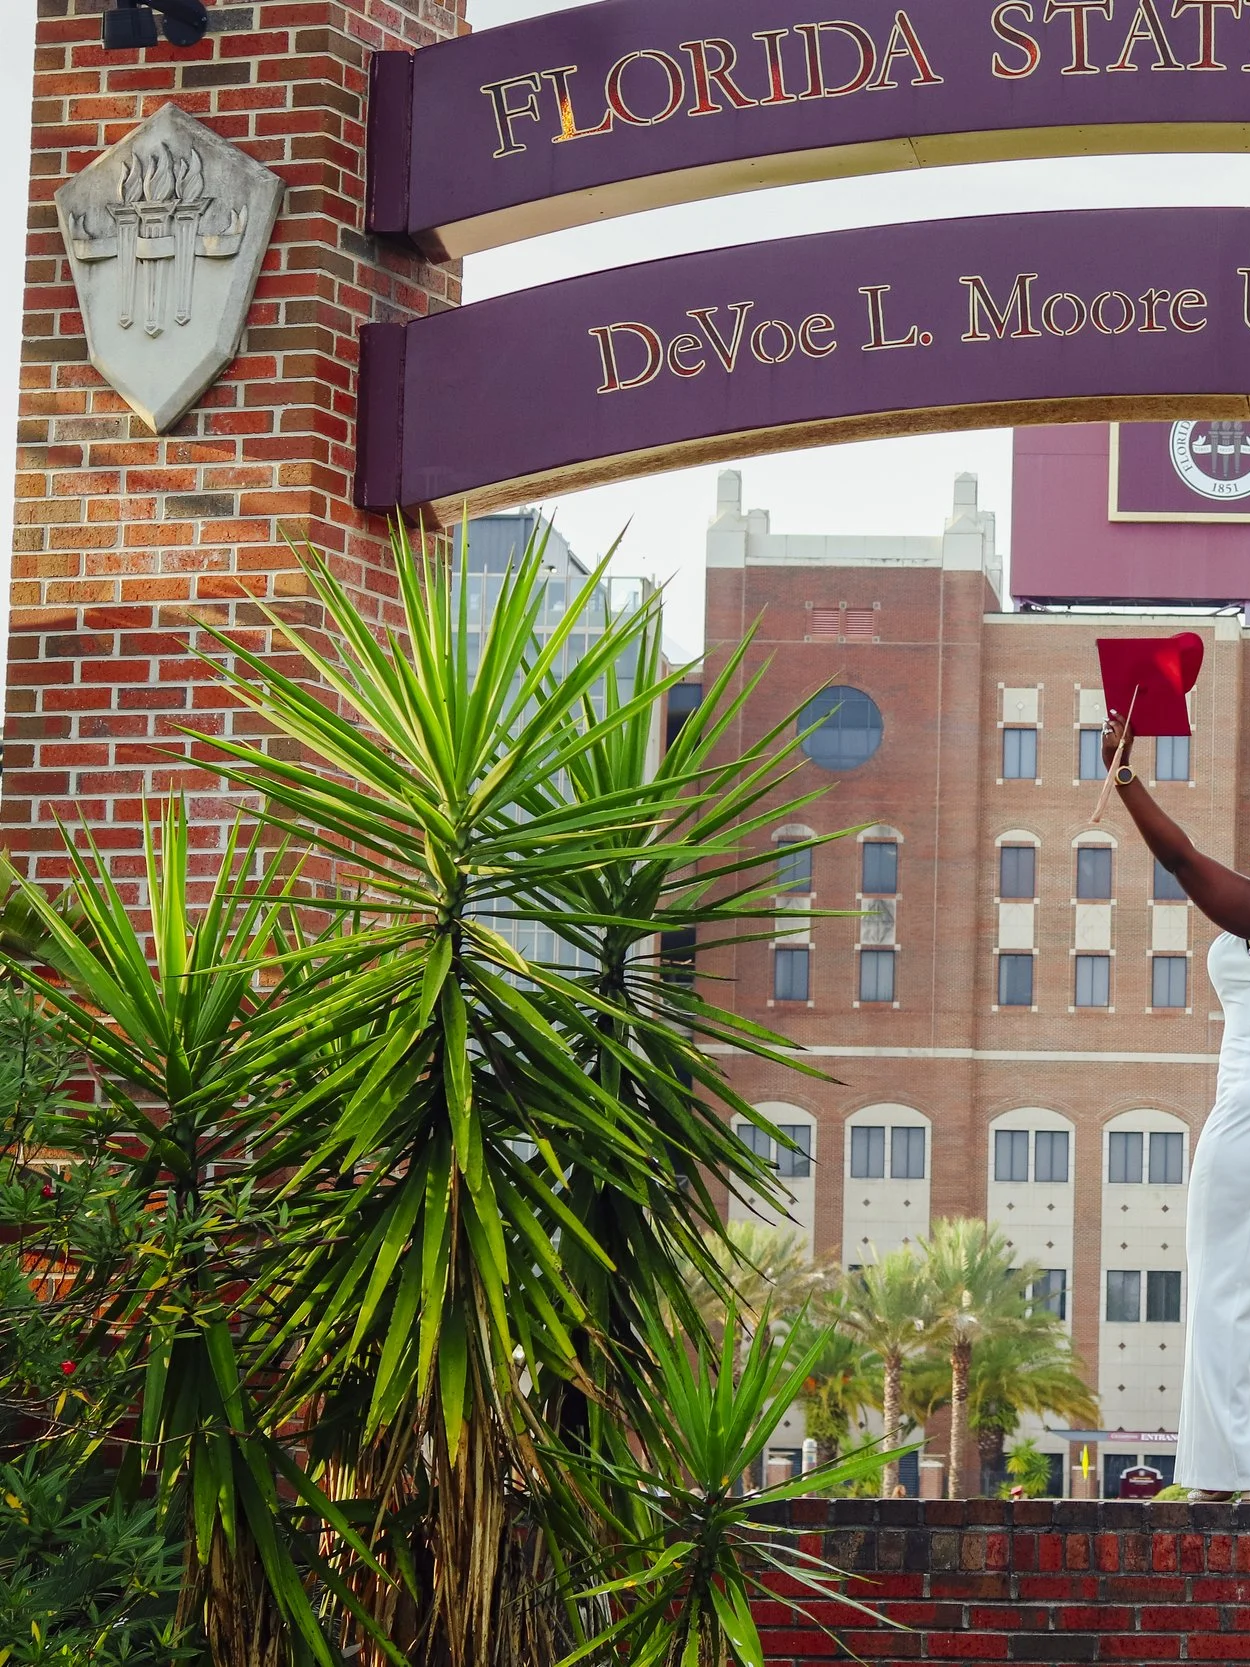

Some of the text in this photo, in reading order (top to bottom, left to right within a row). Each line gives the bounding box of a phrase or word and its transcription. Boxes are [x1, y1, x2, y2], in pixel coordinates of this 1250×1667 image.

[480, 9, 944, 159] FLORIDA
[588, 301, 838, 394] DeVoe
[858, 284, 934, 351] L.
[959, 273, 1208, 342] Moore
[1177, 421, 1193, 472] FLORID
[1212, 483, 1239, 494] 1851
[1141, 1433, 1179, 1441] ENTRAN
